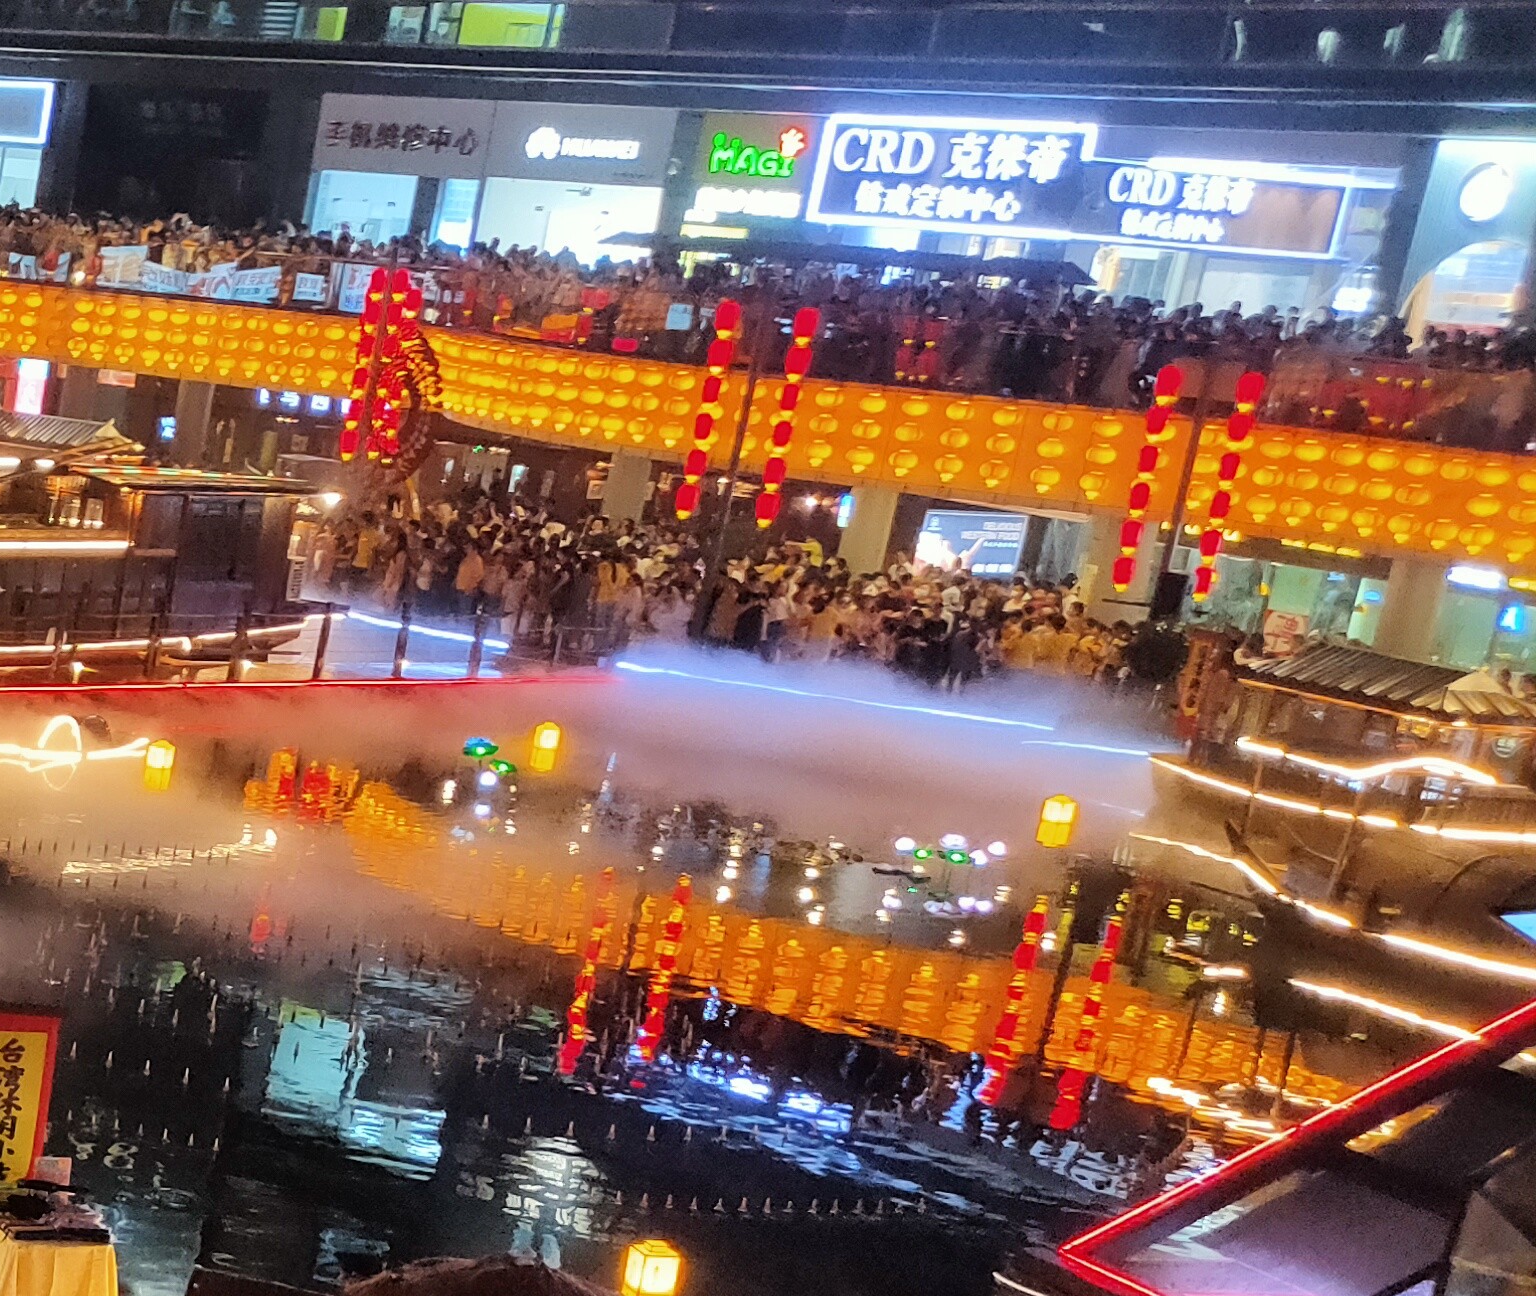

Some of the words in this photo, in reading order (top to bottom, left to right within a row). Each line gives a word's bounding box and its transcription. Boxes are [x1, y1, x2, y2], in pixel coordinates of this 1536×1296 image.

[709, 131, 796, 178] MAGI
[833, 128, 936, 175] CRD
[1108, 167, 1177, 206] CRD
